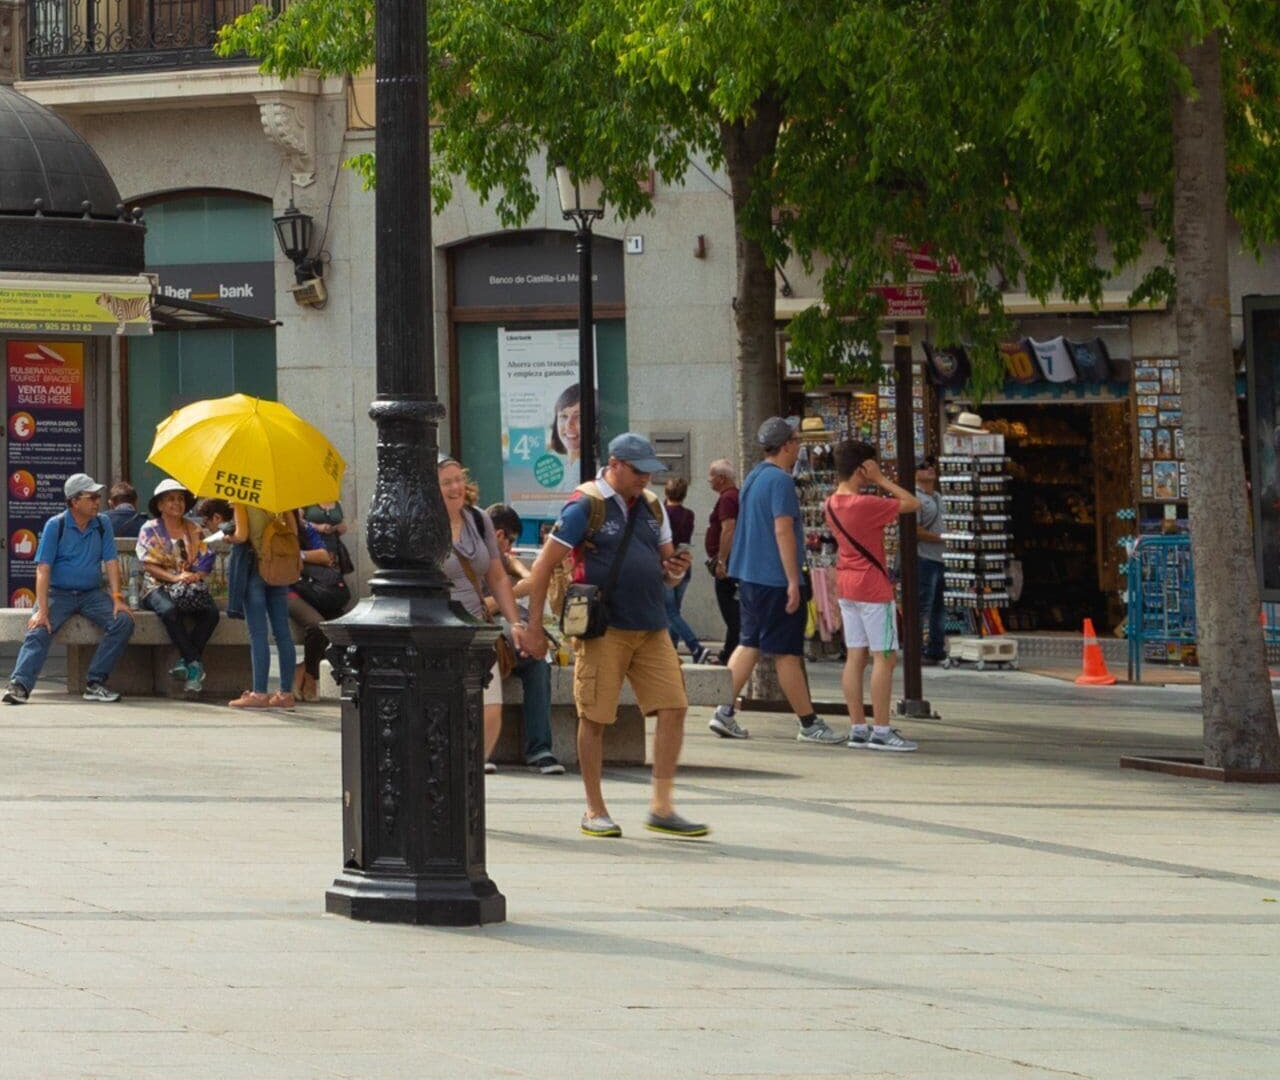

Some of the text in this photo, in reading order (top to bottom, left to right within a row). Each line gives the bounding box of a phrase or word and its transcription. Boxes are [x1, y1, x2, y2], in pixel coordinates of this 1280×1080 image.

[489, 275, 514, 285] Banco
[515, 274, 525, 284] de
[526, 273, 566, 284] Castilla-La
[220, 283, 254, 298] bank
[532, 360, 547, 368] con
[1040, 355, 1053, 376] 7
[514, 369, 542, 378] empieza
[17, 383, 72, 395] VENTA AQUÍ
[17, 394, 72, 405] SALES HERE
[215, 470, 264, 491] FREE
[214, 482, 261, 504] TOUR
